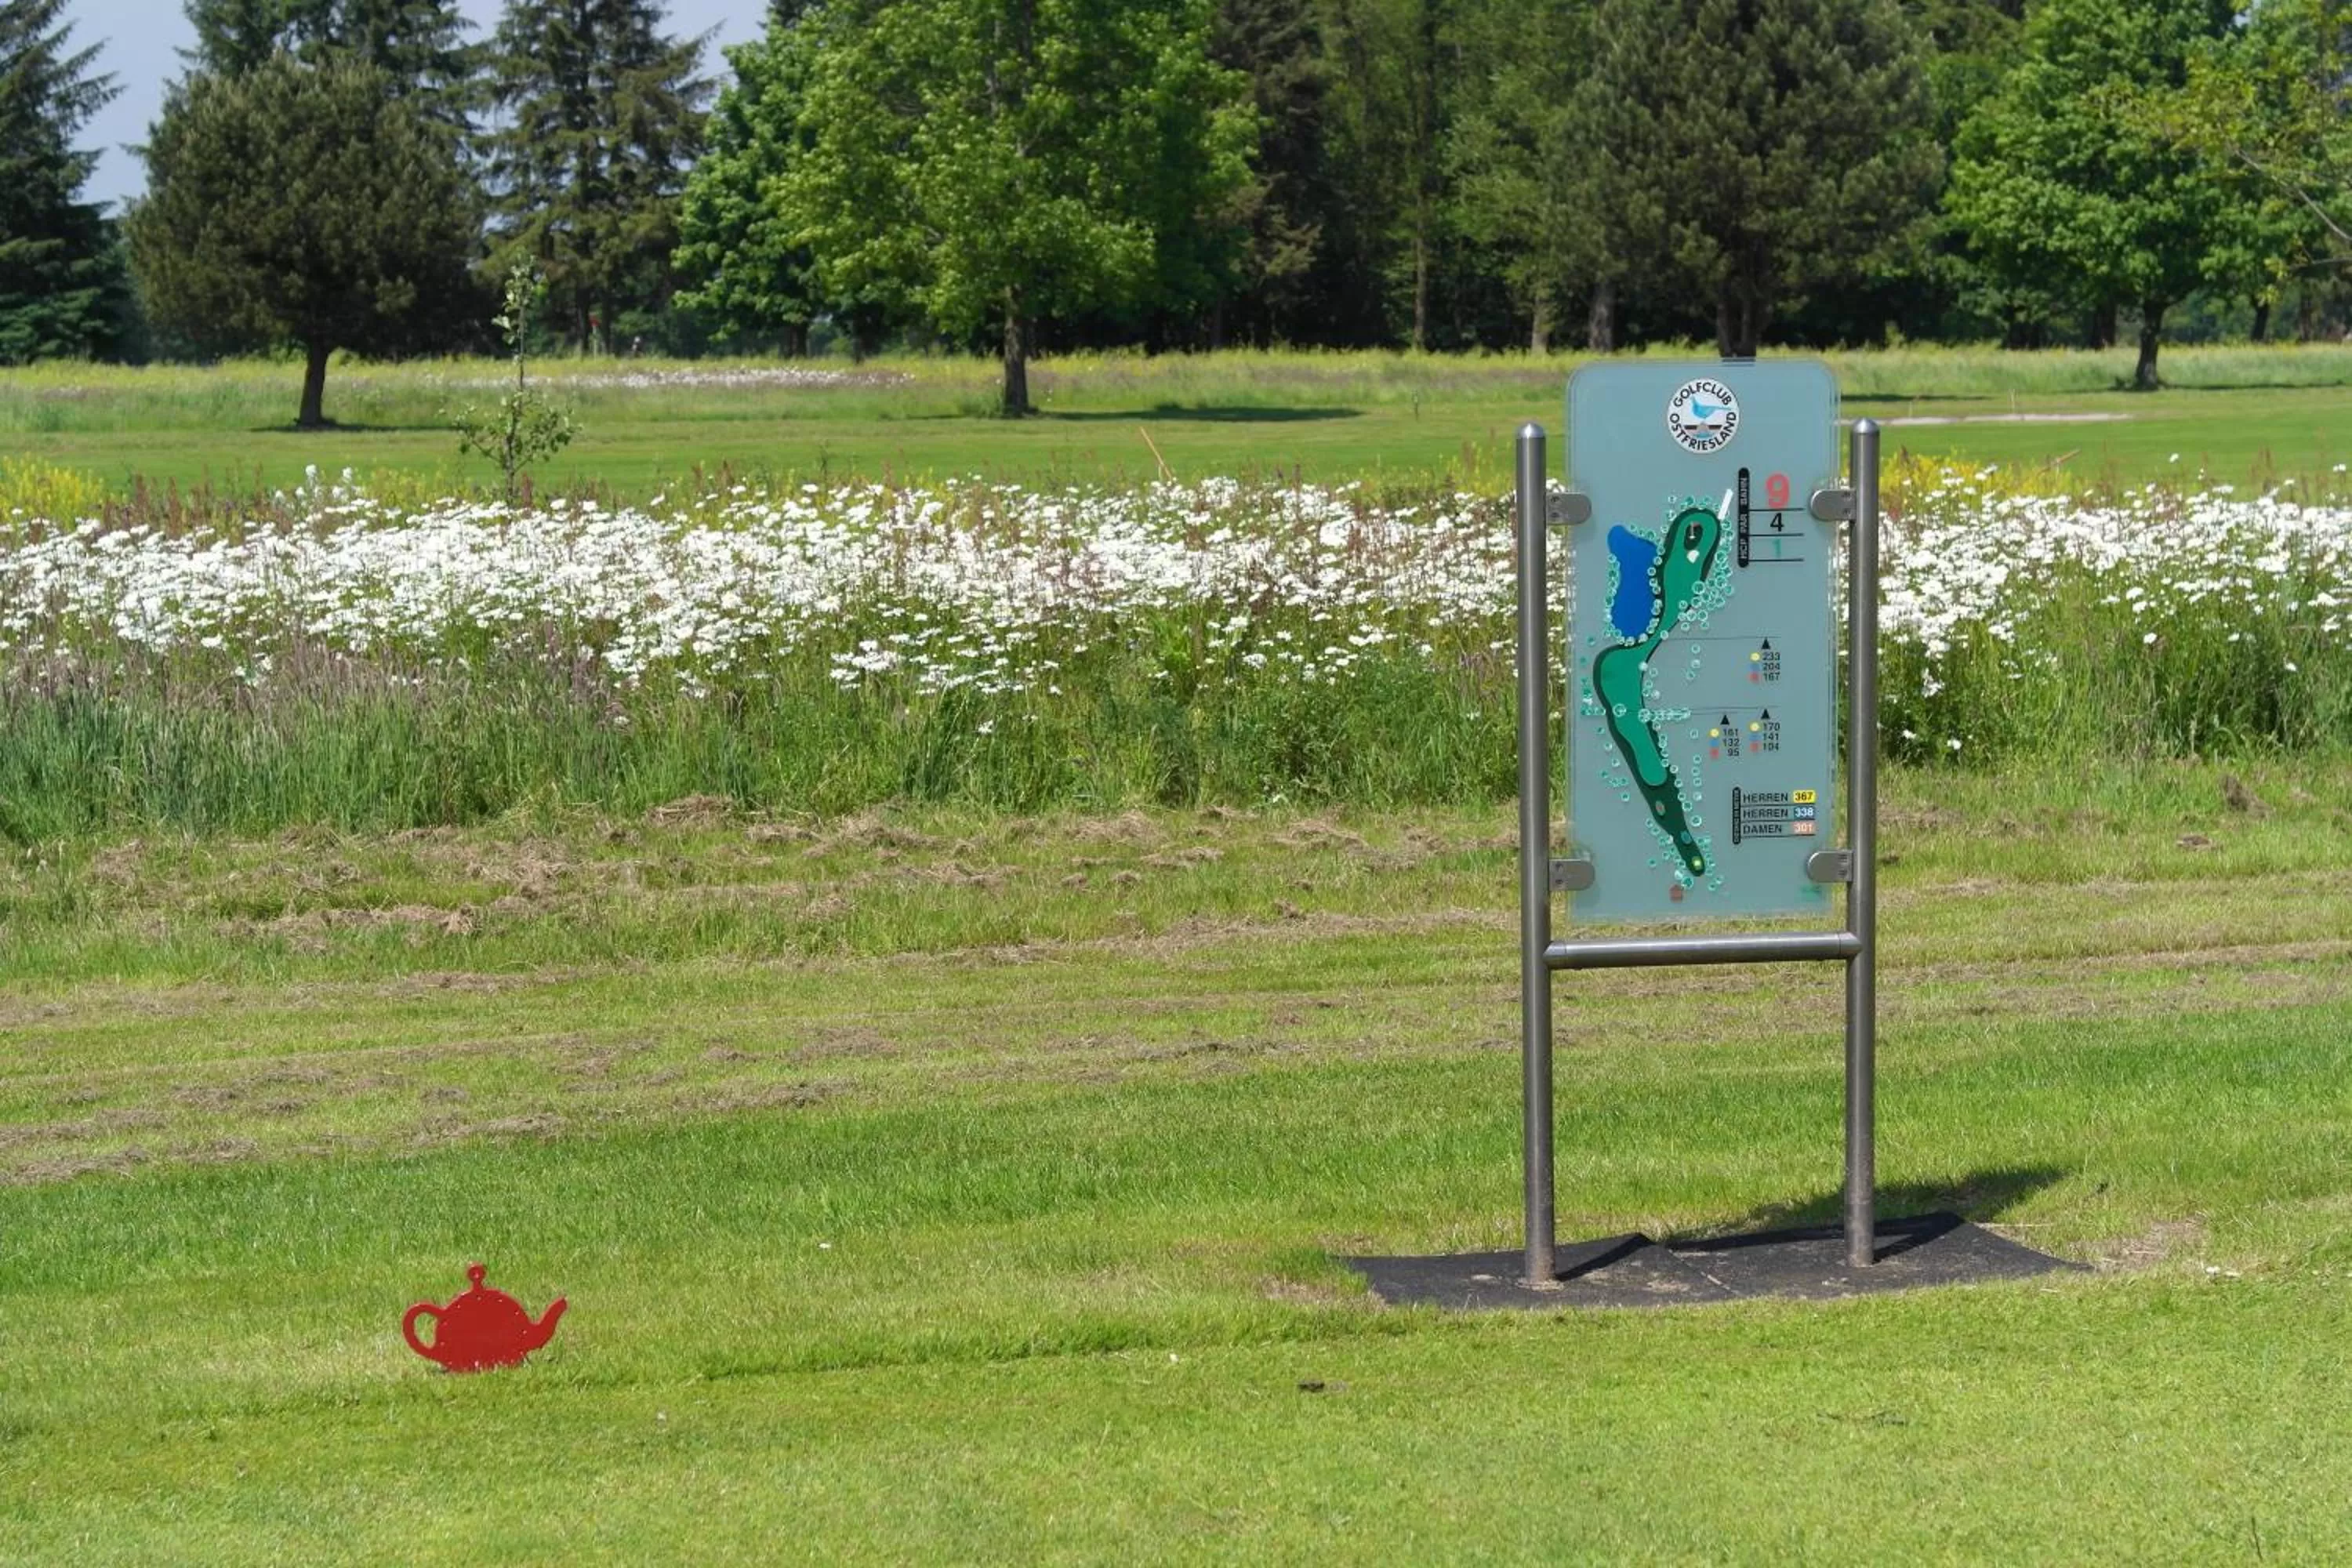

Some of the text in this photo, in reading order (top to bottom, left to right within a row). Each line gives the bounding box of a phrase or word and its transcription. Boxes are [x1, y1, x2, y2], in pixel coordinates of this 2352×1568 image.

[1673, 382, 1732, 407] GOLFCLUB
[1670, 412, 1737, 451] OSTFRIESLAND
[1766, 473, 1790, 509] 9
[1770, 512, 1784, 532] 4
[1773, 539, 1782, 558] 1
[1762, 652, 1780, 661] 233
[1762, 722, 1780, 731] 170
[1722, 728, 1739, 737] 161
[1722, 738, 1740, 747] 132
[1762, 742, 1780, 751] 104
[1727, 748, 1740, 757] 95
[1743, 791, 1813, 803] HERREN 367
[1743, 807, 1814, 818] HERREN 338
[1743, 823, 1813, 835] DAMEN 301
